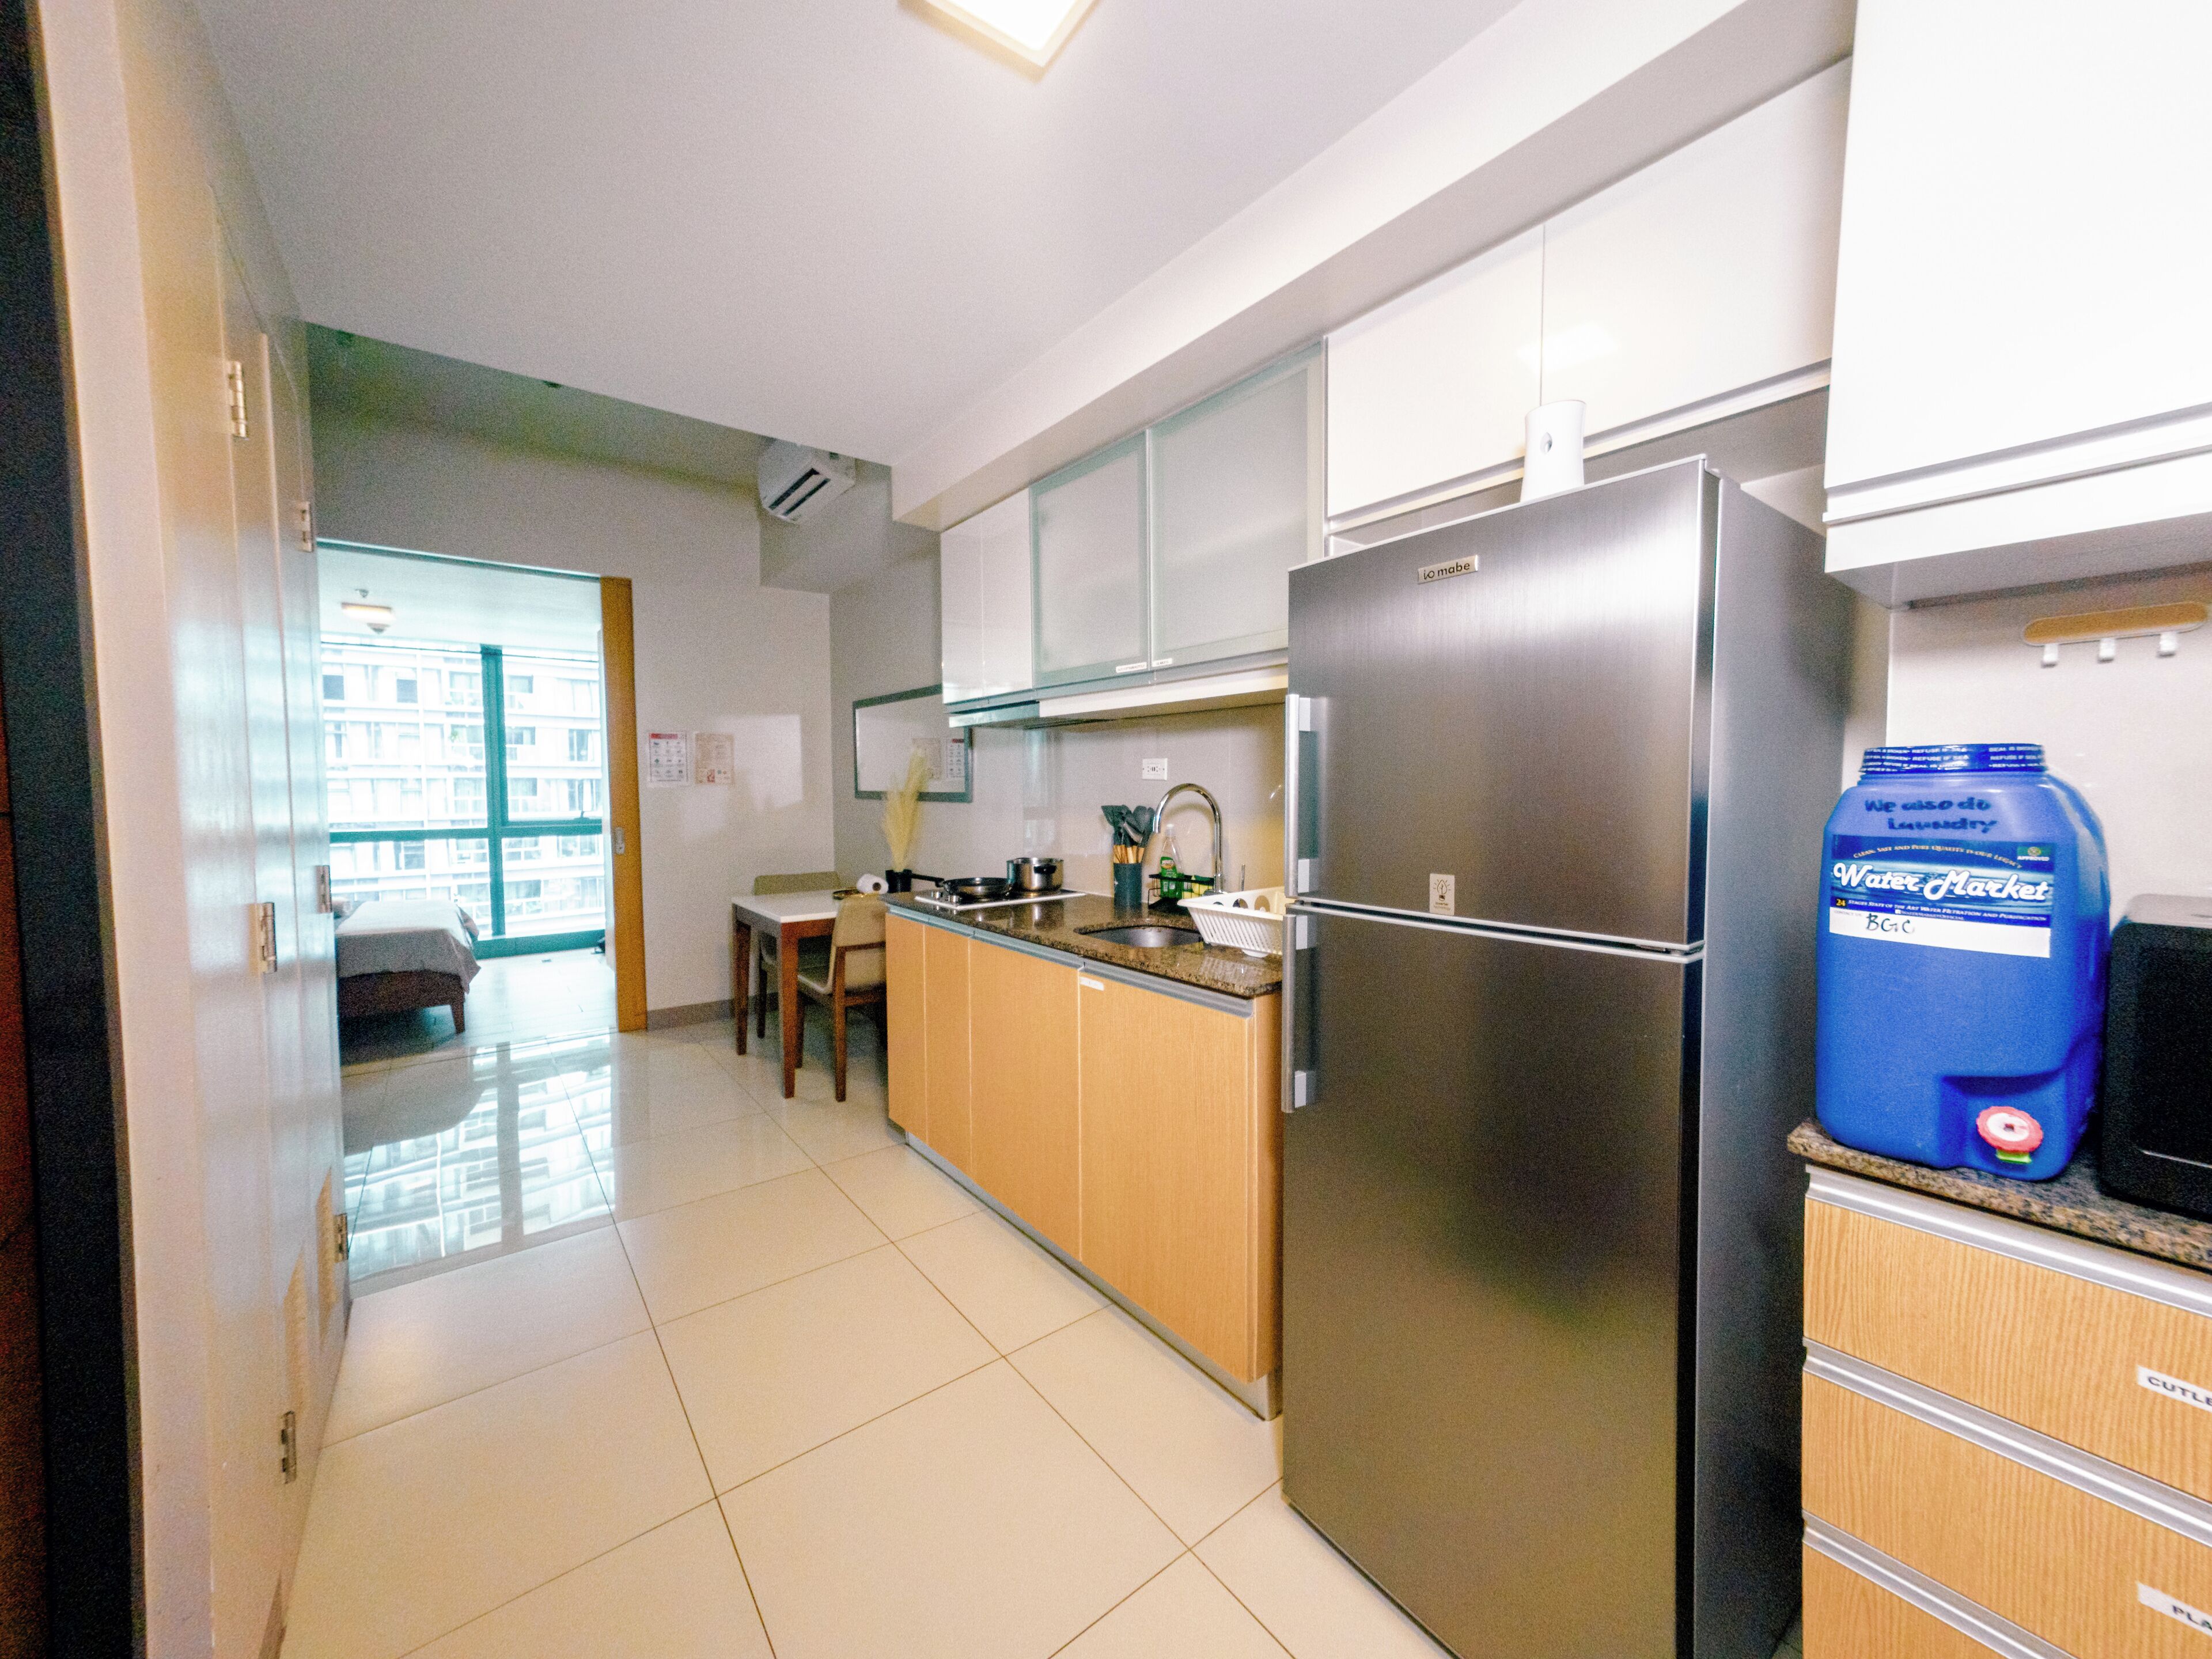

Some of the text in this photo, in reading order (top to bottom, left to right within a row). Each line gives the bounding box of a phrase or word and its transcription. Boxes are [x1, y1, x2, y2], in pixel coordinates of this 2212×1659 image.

[1438, 562, 1470, 576] mabe
[1865, 799, 1896, 813] We
[1957, 797, 1991, 810] do
[1833, 862, 2050, 901] Water Market
[1836, 899, 1846, 907] 24
[1942, 908, 1982, 916] FILTRATION
[1999, 913, 2047, 921] PURIFICATION
[1866, 913, 1915, 934] BGC
[2147, 1376, 2212, 1407] CUTLE
